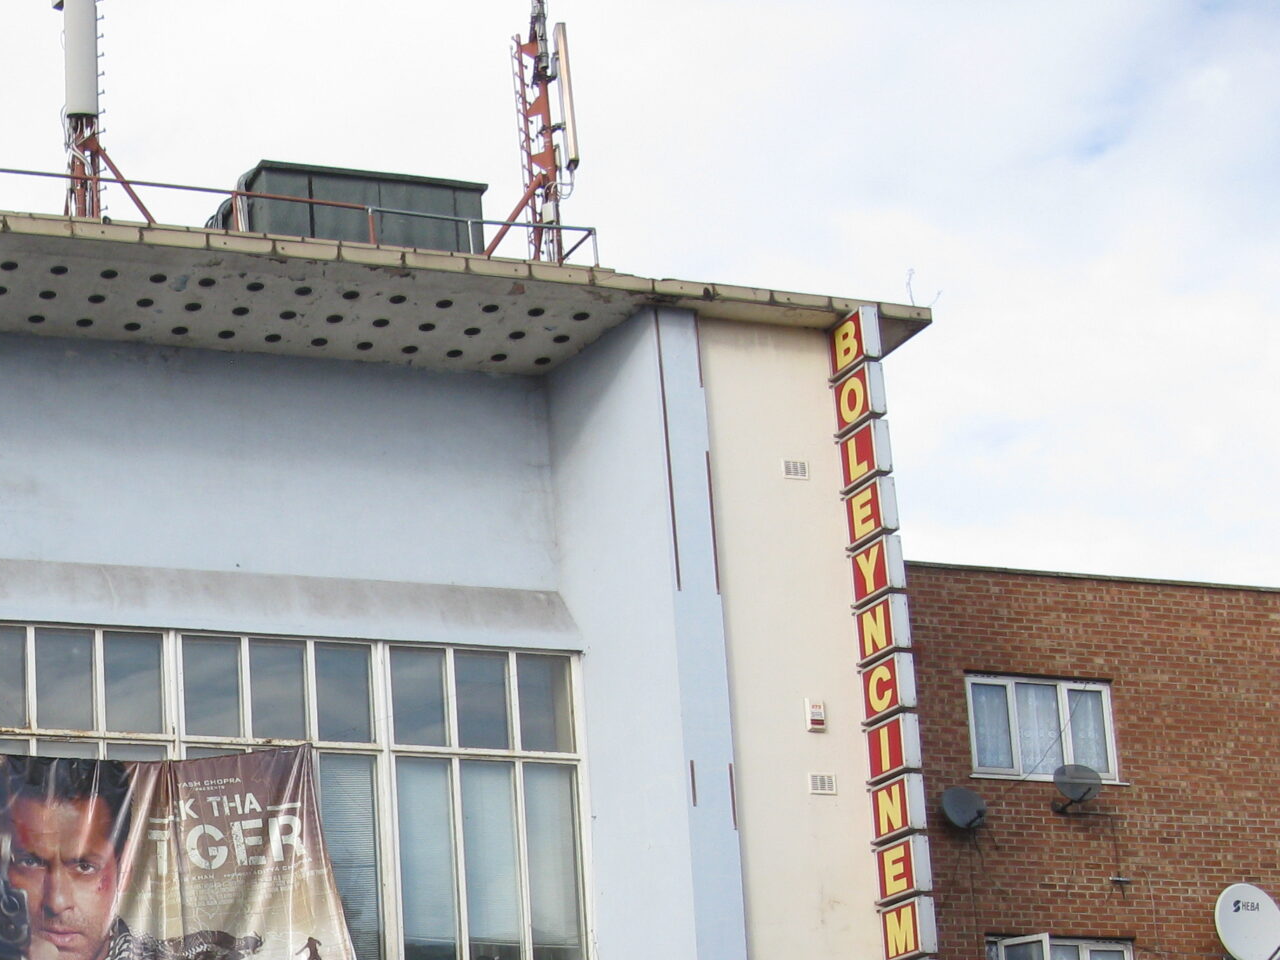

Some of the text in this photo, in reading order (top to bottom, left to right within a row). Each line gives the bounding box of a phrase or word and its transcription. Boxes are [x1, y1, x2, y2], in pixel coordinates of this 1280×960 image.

[833, 319, 888, 658] BOLEYN
[204, 777, 242, 786] CHOPRA
[206, 792, 263, 817] THA
[148, 814, 308, 876] TGER
